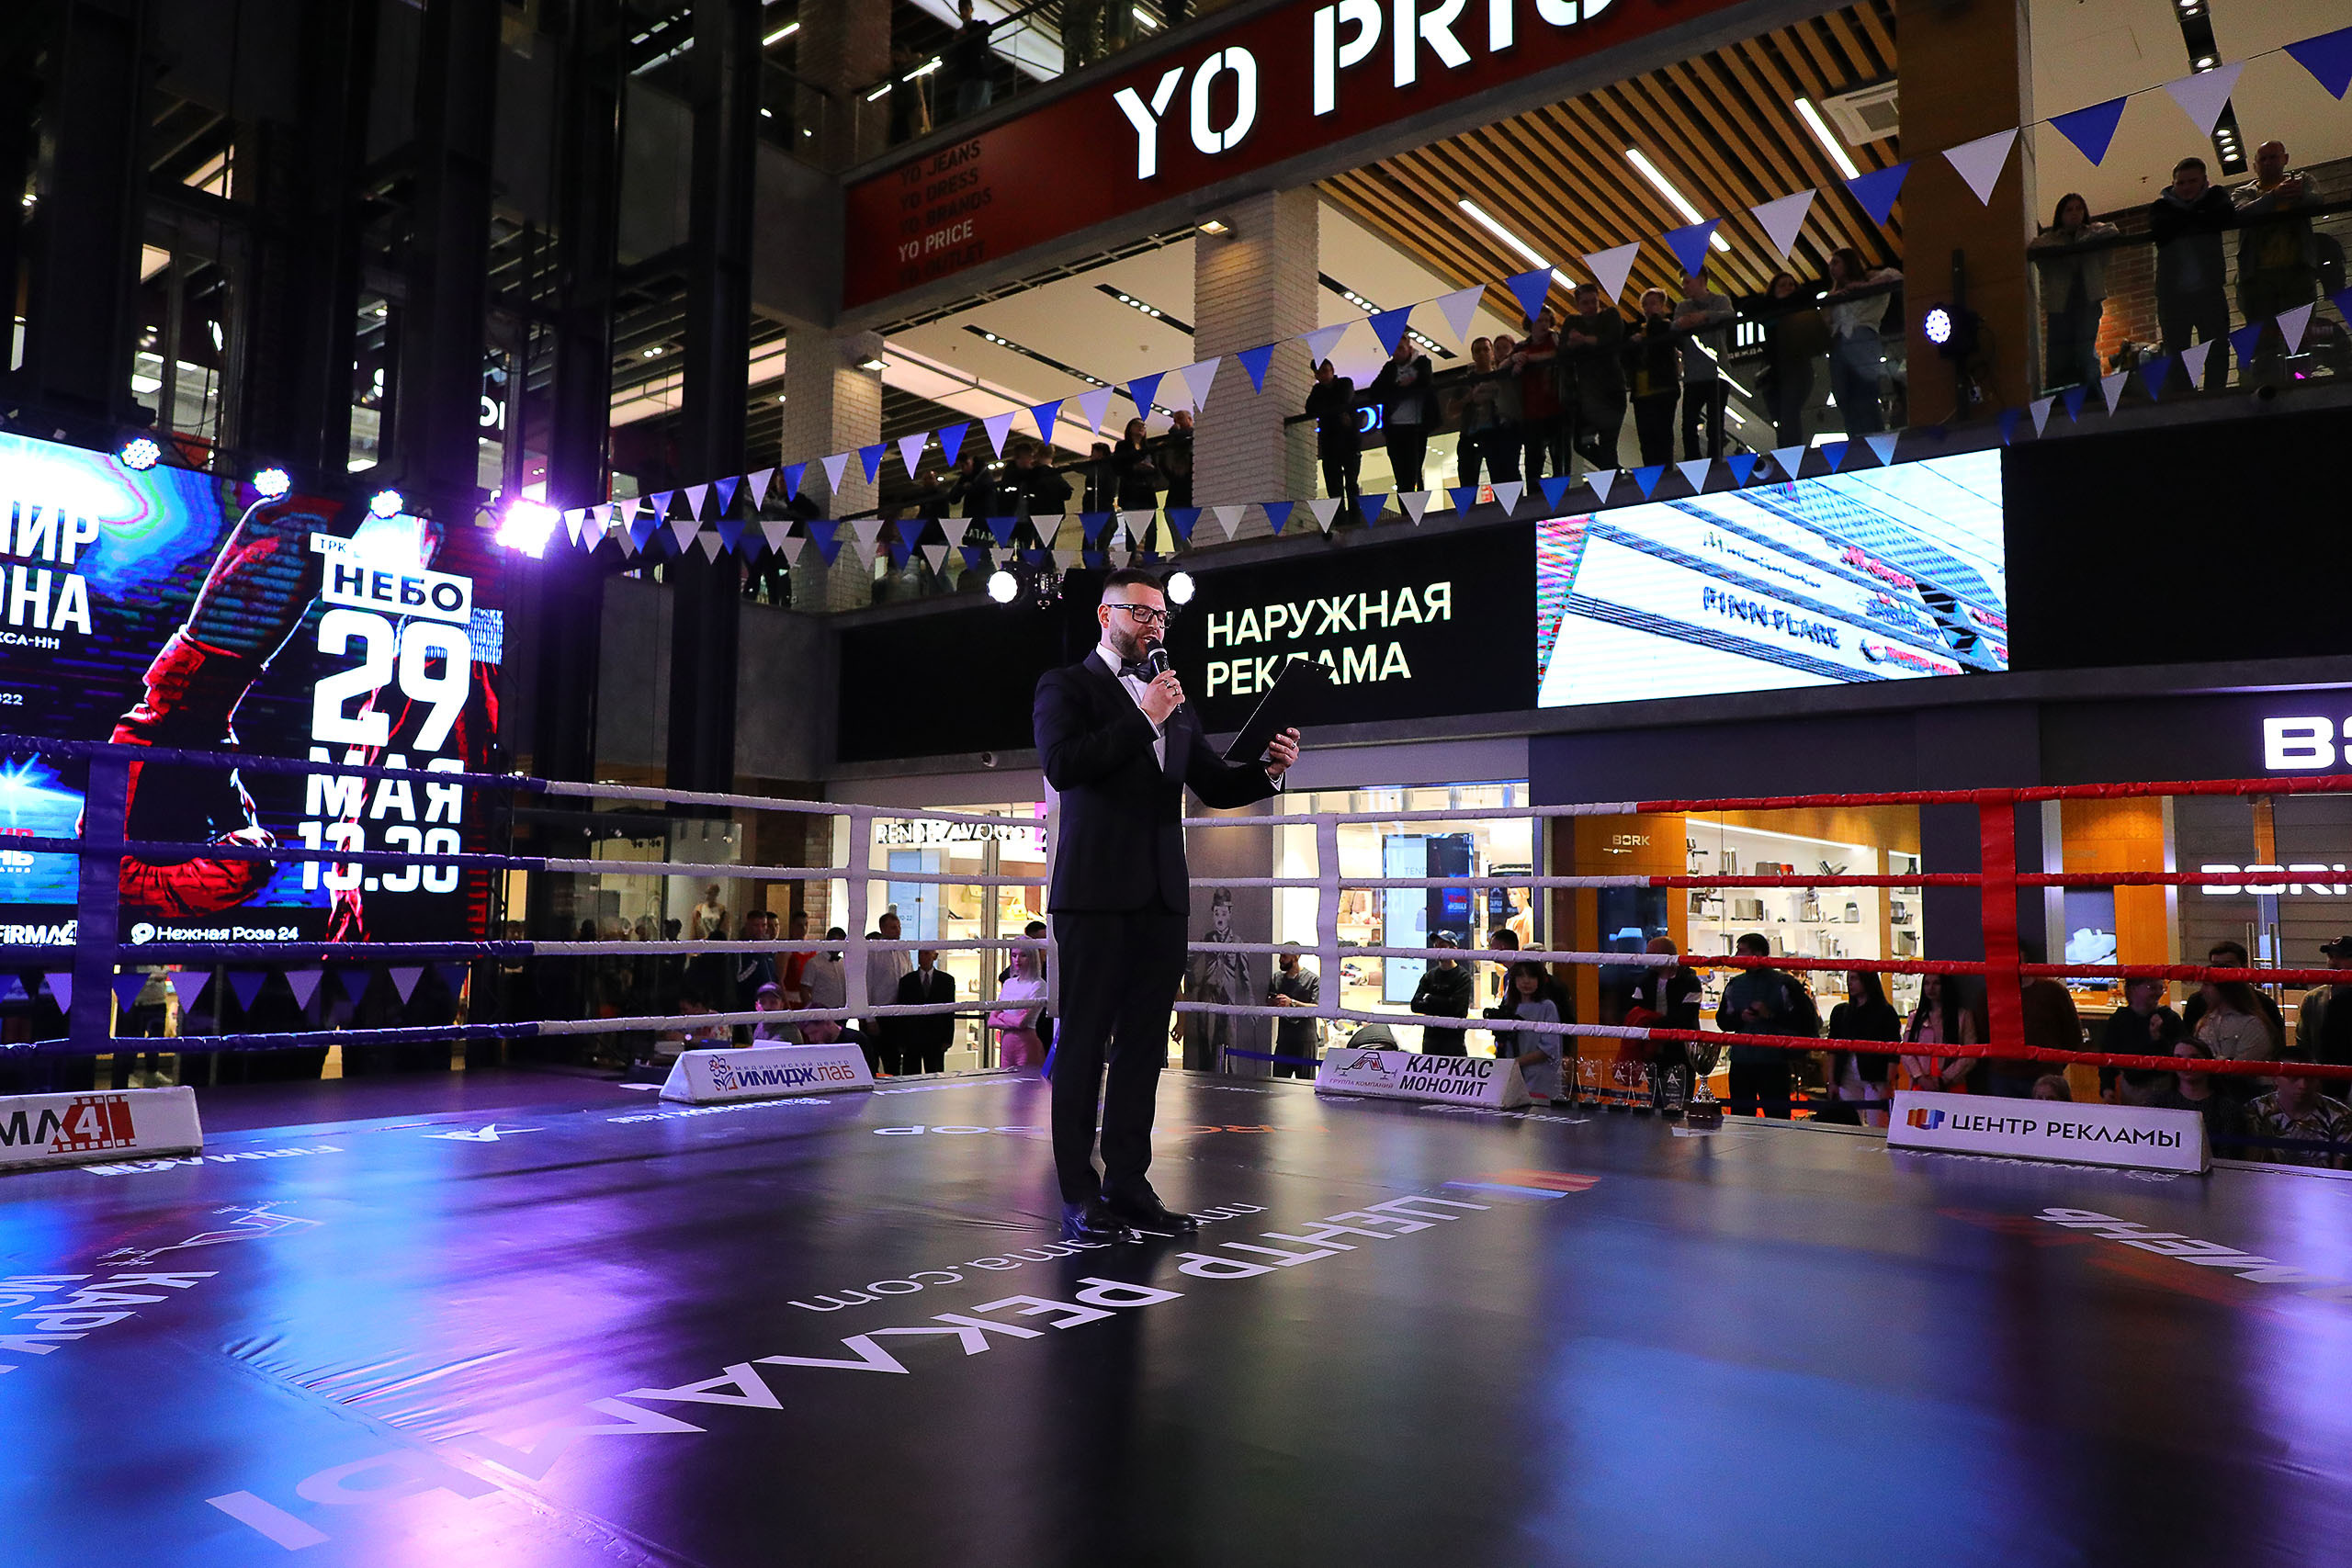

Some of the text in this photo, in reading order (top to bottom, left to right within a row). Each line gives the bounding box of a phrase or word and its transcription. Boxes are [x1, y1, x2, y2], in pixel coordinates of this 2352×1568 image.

[1114, 46, 1258, 180] YO
[928, 140, 981, 176] JEANS
[926, 168, 979, 202] DRESS
[898, 219, 974, 263] YO PRICE
[0, 501, 100, 565] ИР
[320, 538, 346, 554] ТРК
[0, 562, 93, 635] НА
[333, 564, 465, 613] НЕБО
[1206, 581, 1452, 649] НАРУЖНАЯ
[311, 608, 472, 752] 29
[305, 745, 466, 824] МАЯ
[1612, 834, 1651, 847] BORK
[156, 926, 299, 941] Нежная Роза 24
[736, 1066, 820, 1088] ИМИДЖ
[1398, 1075, 1488, 1098] МОНОЛИТ
[1405, 1055, 1494, 1079] КАРКАС
[1951, 1112, 2182, 1149] ЦЕНТР РЕКЛАМЫ
[1175, 1195, 1491, 1280] ЦЕНТР
